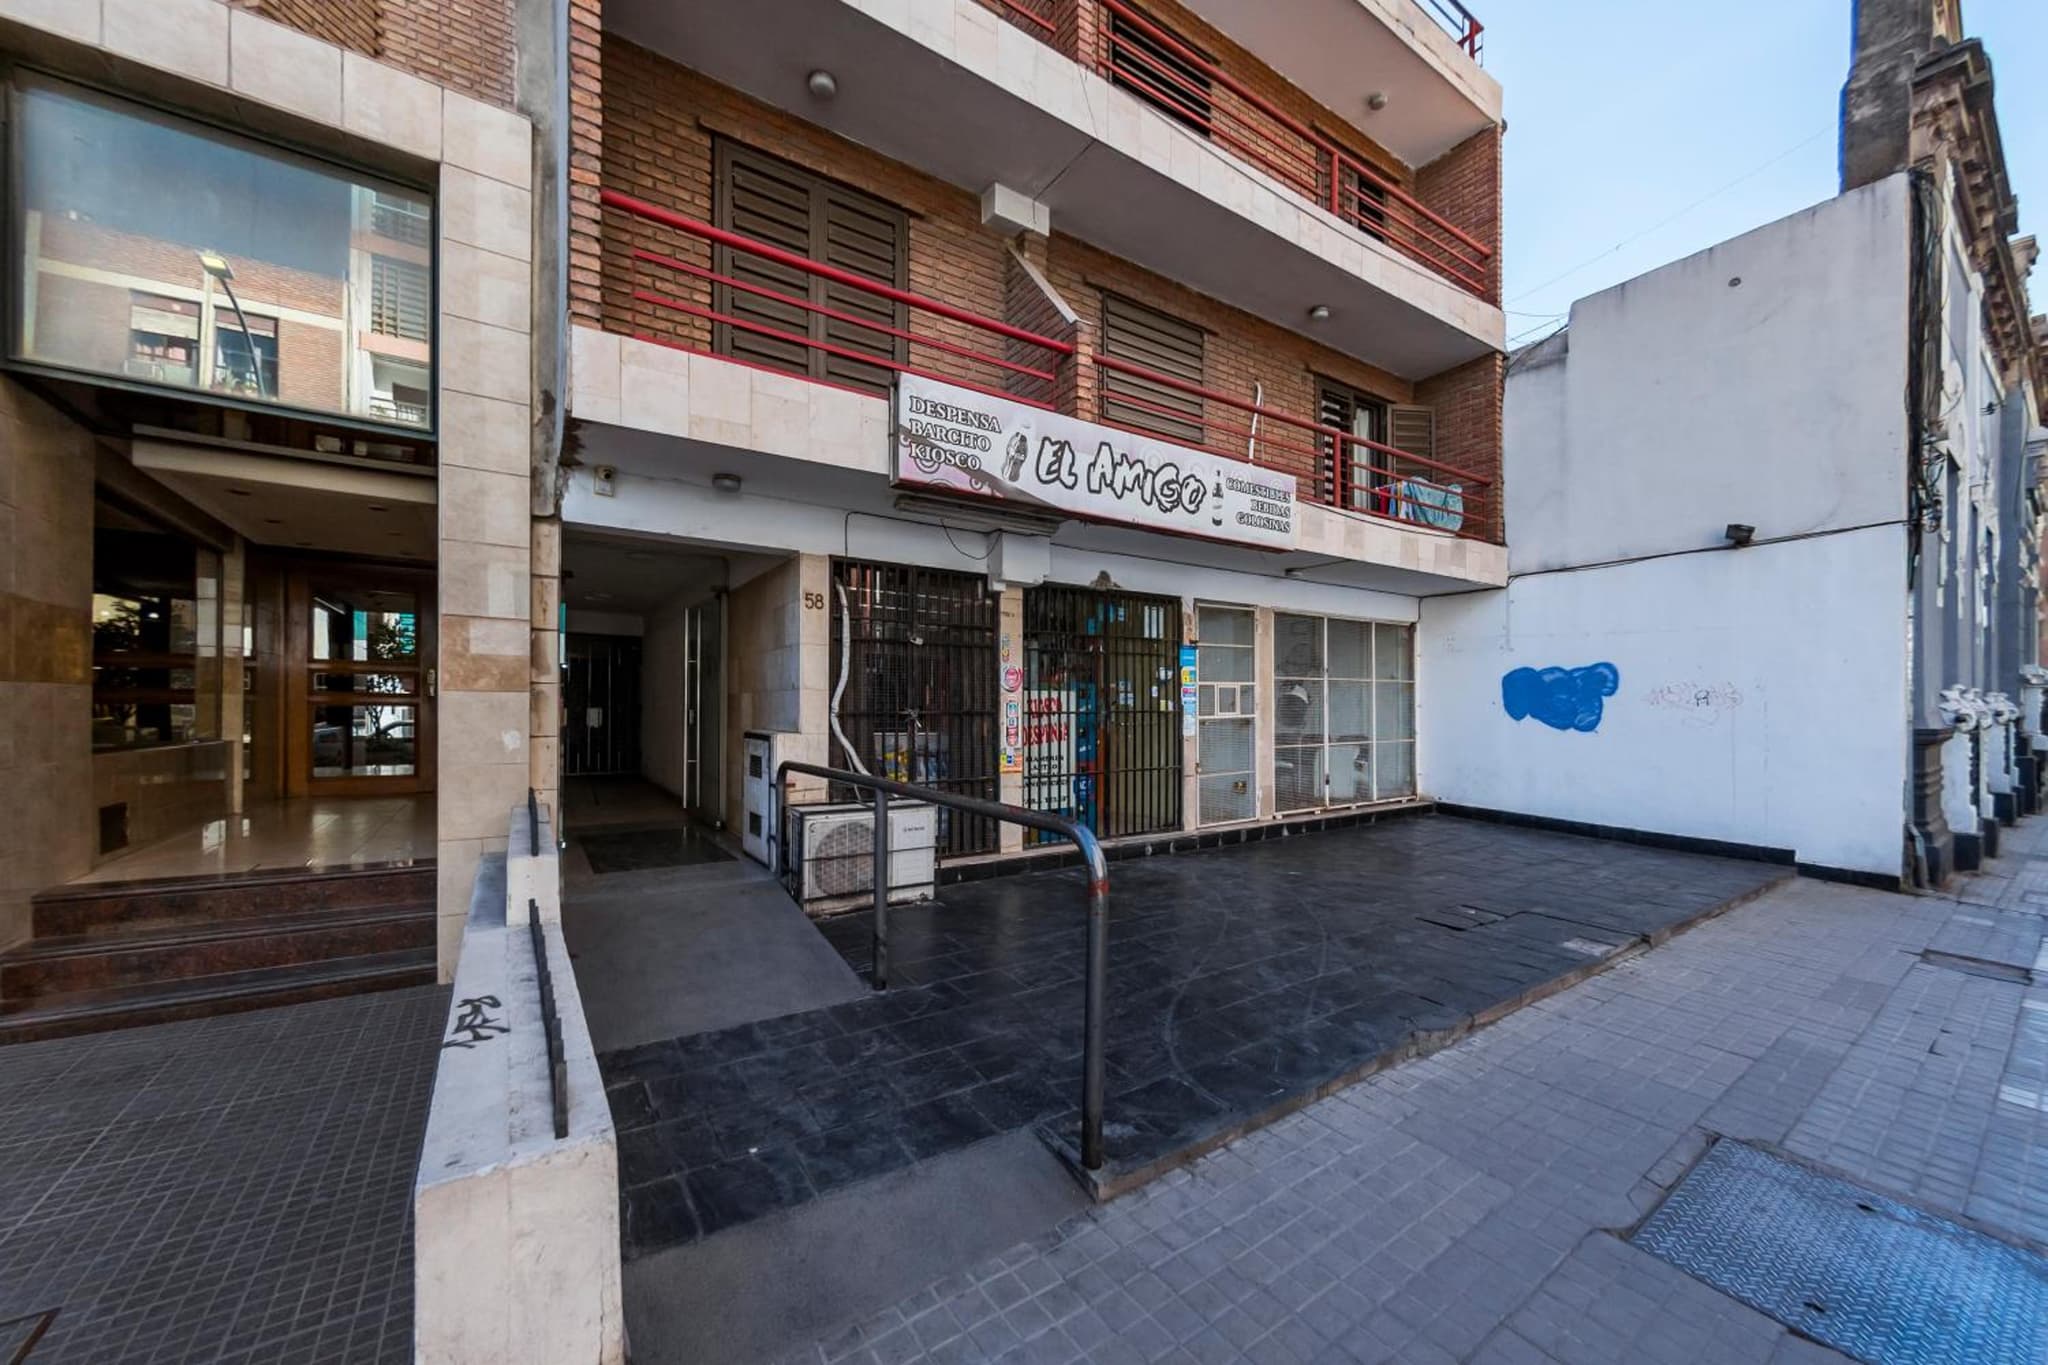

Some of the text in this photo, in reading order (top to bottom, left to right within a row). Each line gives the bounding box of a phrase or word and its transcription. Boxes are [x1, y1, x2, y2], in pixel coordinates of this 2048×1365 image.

[909, 395, 1002, 434] DESPENSA
[909, 418, 991, 452] BARCITO
[909, 440, 981, 471] KIOSCO
[1036, 436, 1207, 514] EL AMIGO
[1236, 511, 1291, 533] GOLOSINAS
[1250, 499, 1291, 519] BEBIDAS
[804, 592, 824, 609] 58
